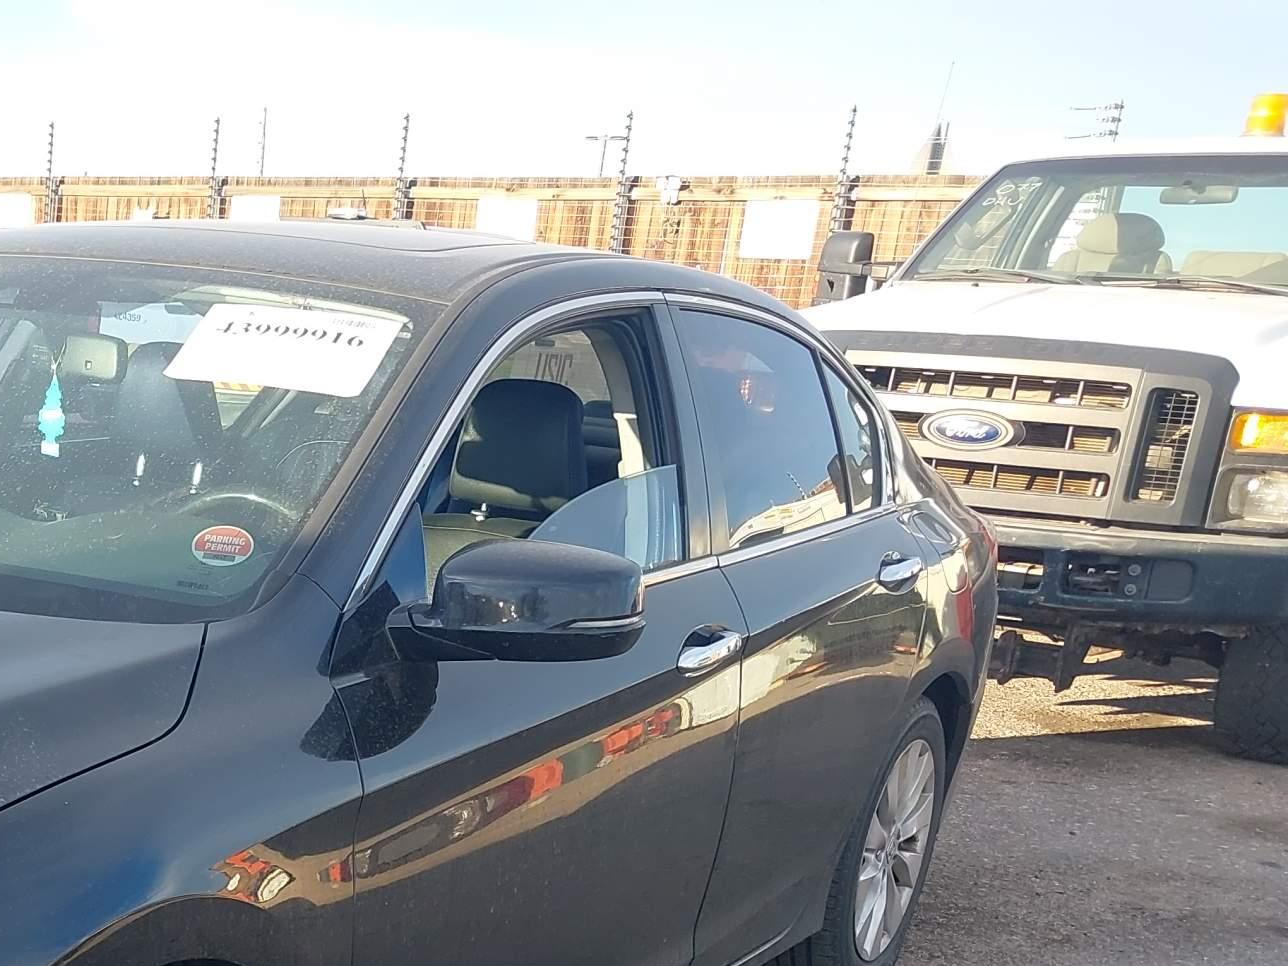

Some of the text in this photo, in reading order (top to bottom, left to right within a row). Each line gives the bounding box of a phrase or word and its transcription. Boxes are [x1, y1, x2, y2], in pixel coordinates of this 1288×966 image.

[216, 321, 364, 347] 43999916
[938, 419, 990, 439] Ford
[203, 534, 246, 546] PARKING
[204, 542, 243, 553] PERMIT
